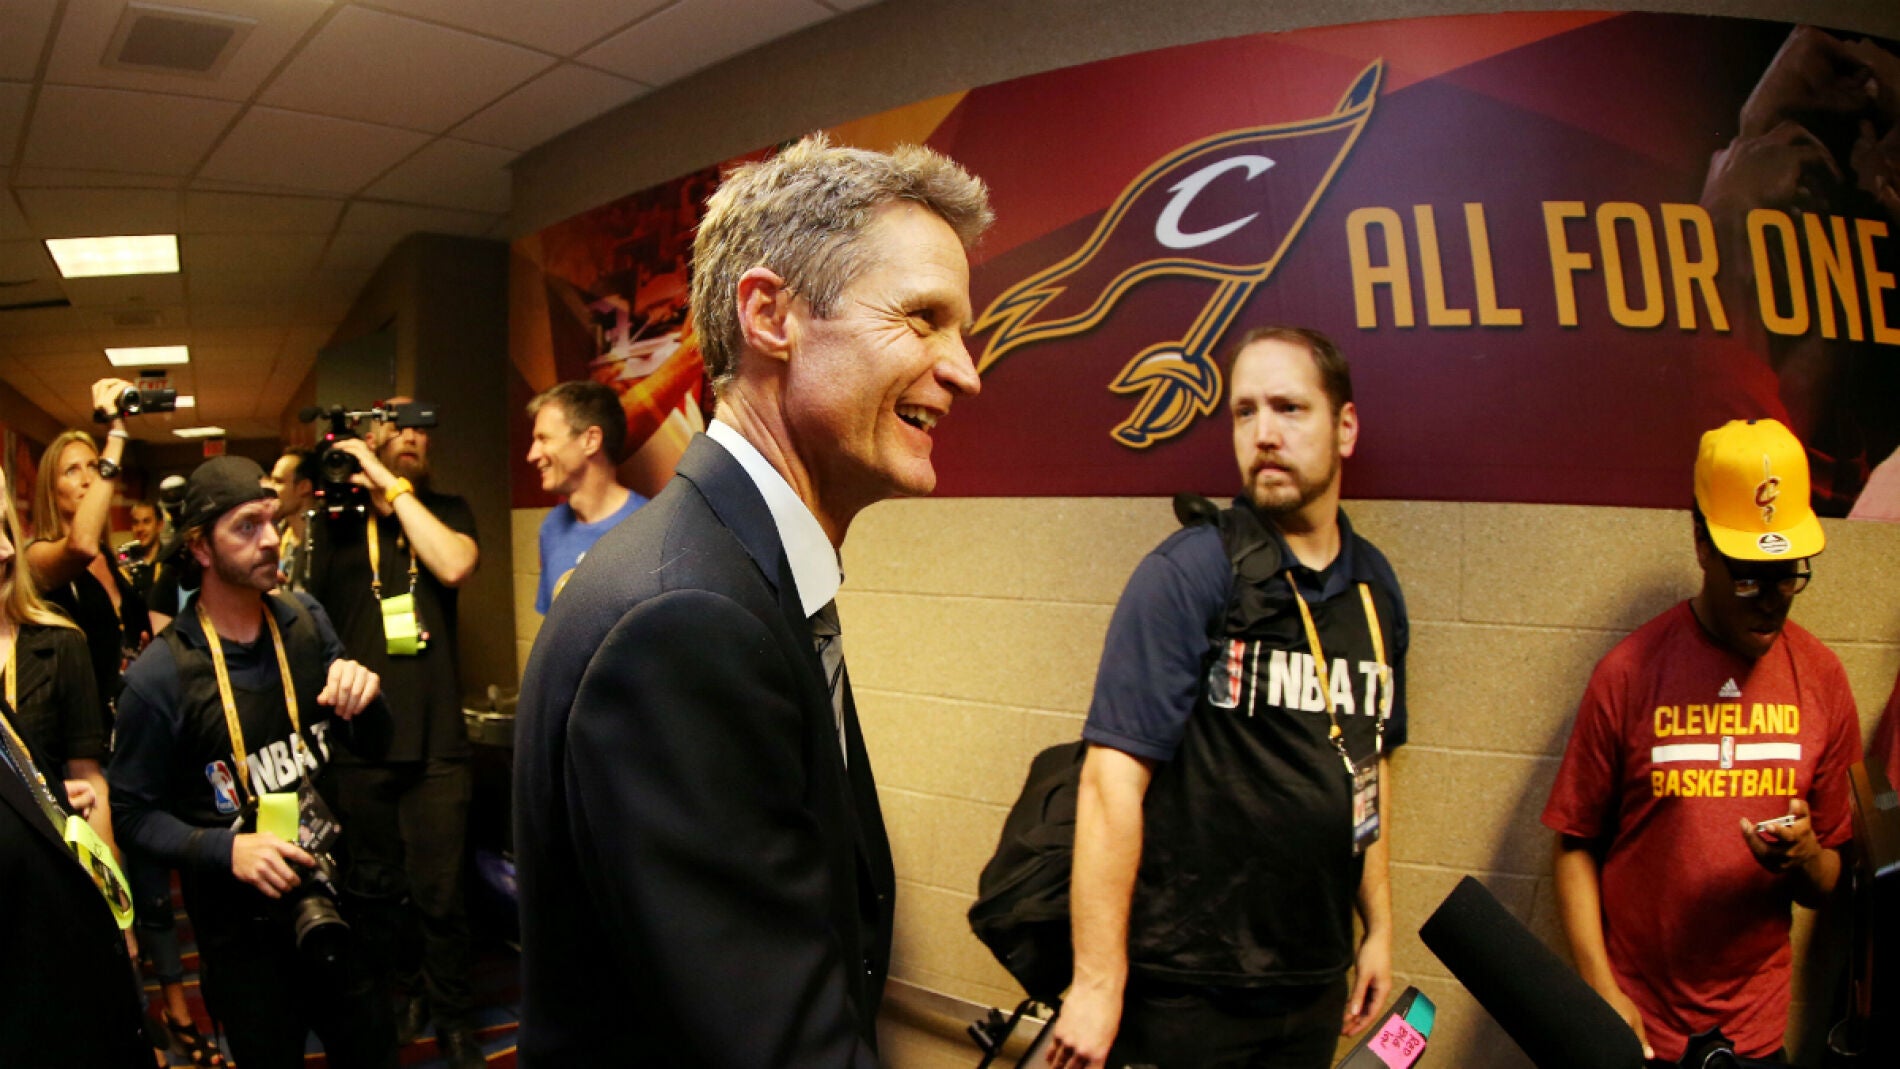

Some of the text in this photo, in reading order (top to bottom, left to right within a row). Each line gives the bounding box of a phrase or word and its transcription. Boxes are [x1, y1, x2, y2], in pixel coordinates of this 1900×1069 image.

[1155, 154, 1276, 249] C
[1346, 201, 1900, 345] ALL FOR ONE
[1267, 650, 1355, 715] NBA
[1653, 702, 1800, 738] CLEVELAND
[247, 732, 318, 797] NBA
[1651, 767, 1798, 798] BASKETBALL
